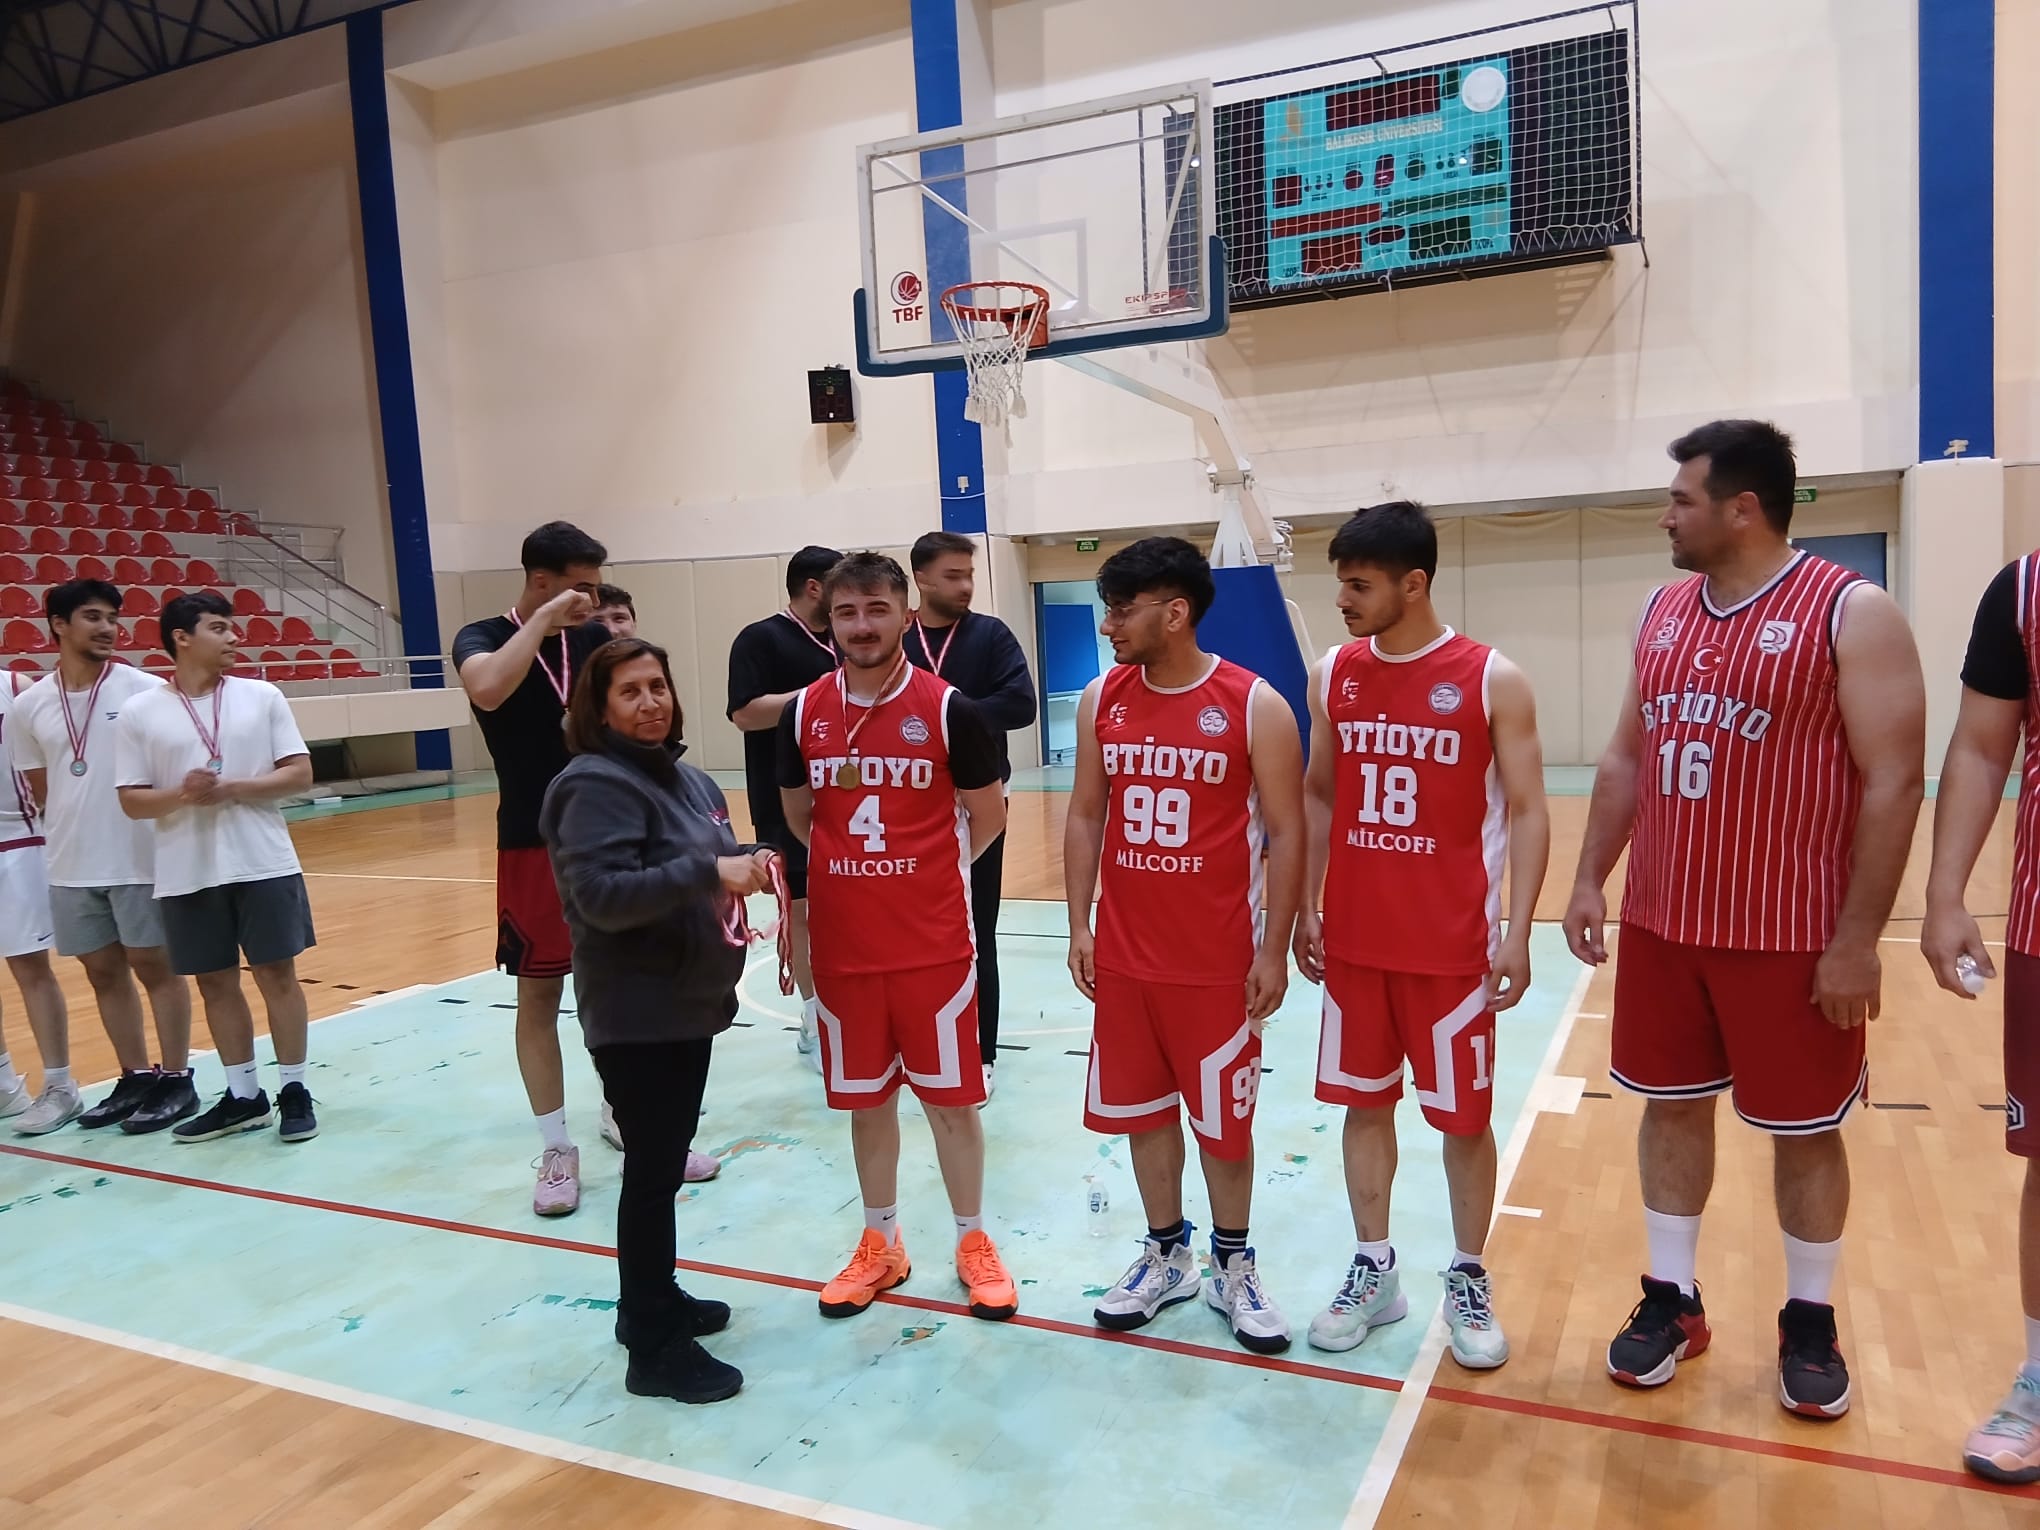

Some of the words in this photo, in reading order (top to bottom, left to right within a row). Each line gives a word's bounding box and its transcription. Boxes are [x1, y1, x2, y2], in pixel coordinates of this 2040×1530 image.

[892, 305, 924, 324] TBF
[1102, 736, 1228, 785] BTİOYO
[1659, 739, 1711, 800] 16
[1123, 785, 1191, 848] 99
[1358, 763, 1418, 828] 18
[848, 795, 886, 853] 4
[1346, 828, 1436, 855] MİLCOFF
[828, 857, 917, 877] MİLCOFF
[1116, 848, 1203, 873] MİLCOFF
[1470, 1027, 1494, 1091] 1
